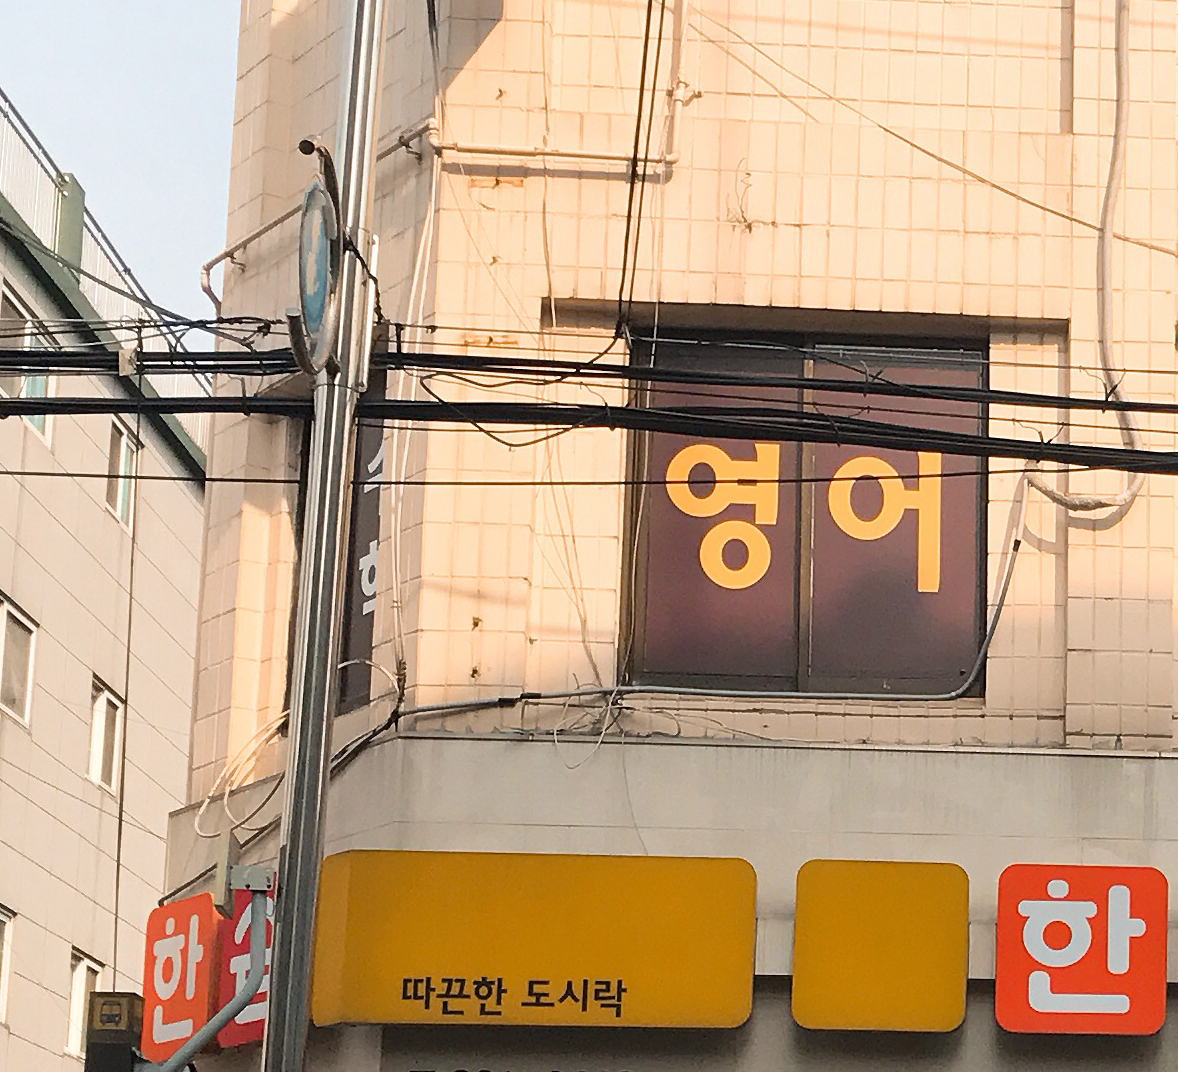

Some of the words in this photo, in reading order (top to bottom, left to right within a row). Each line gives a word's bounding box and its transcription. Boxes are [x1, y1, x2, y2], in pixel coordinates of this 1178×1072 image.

[665, 440, 942, 593] 영어
[401, 976, 508, 1016] 따끈한
[520, 978, 628, 1018] 도시락
